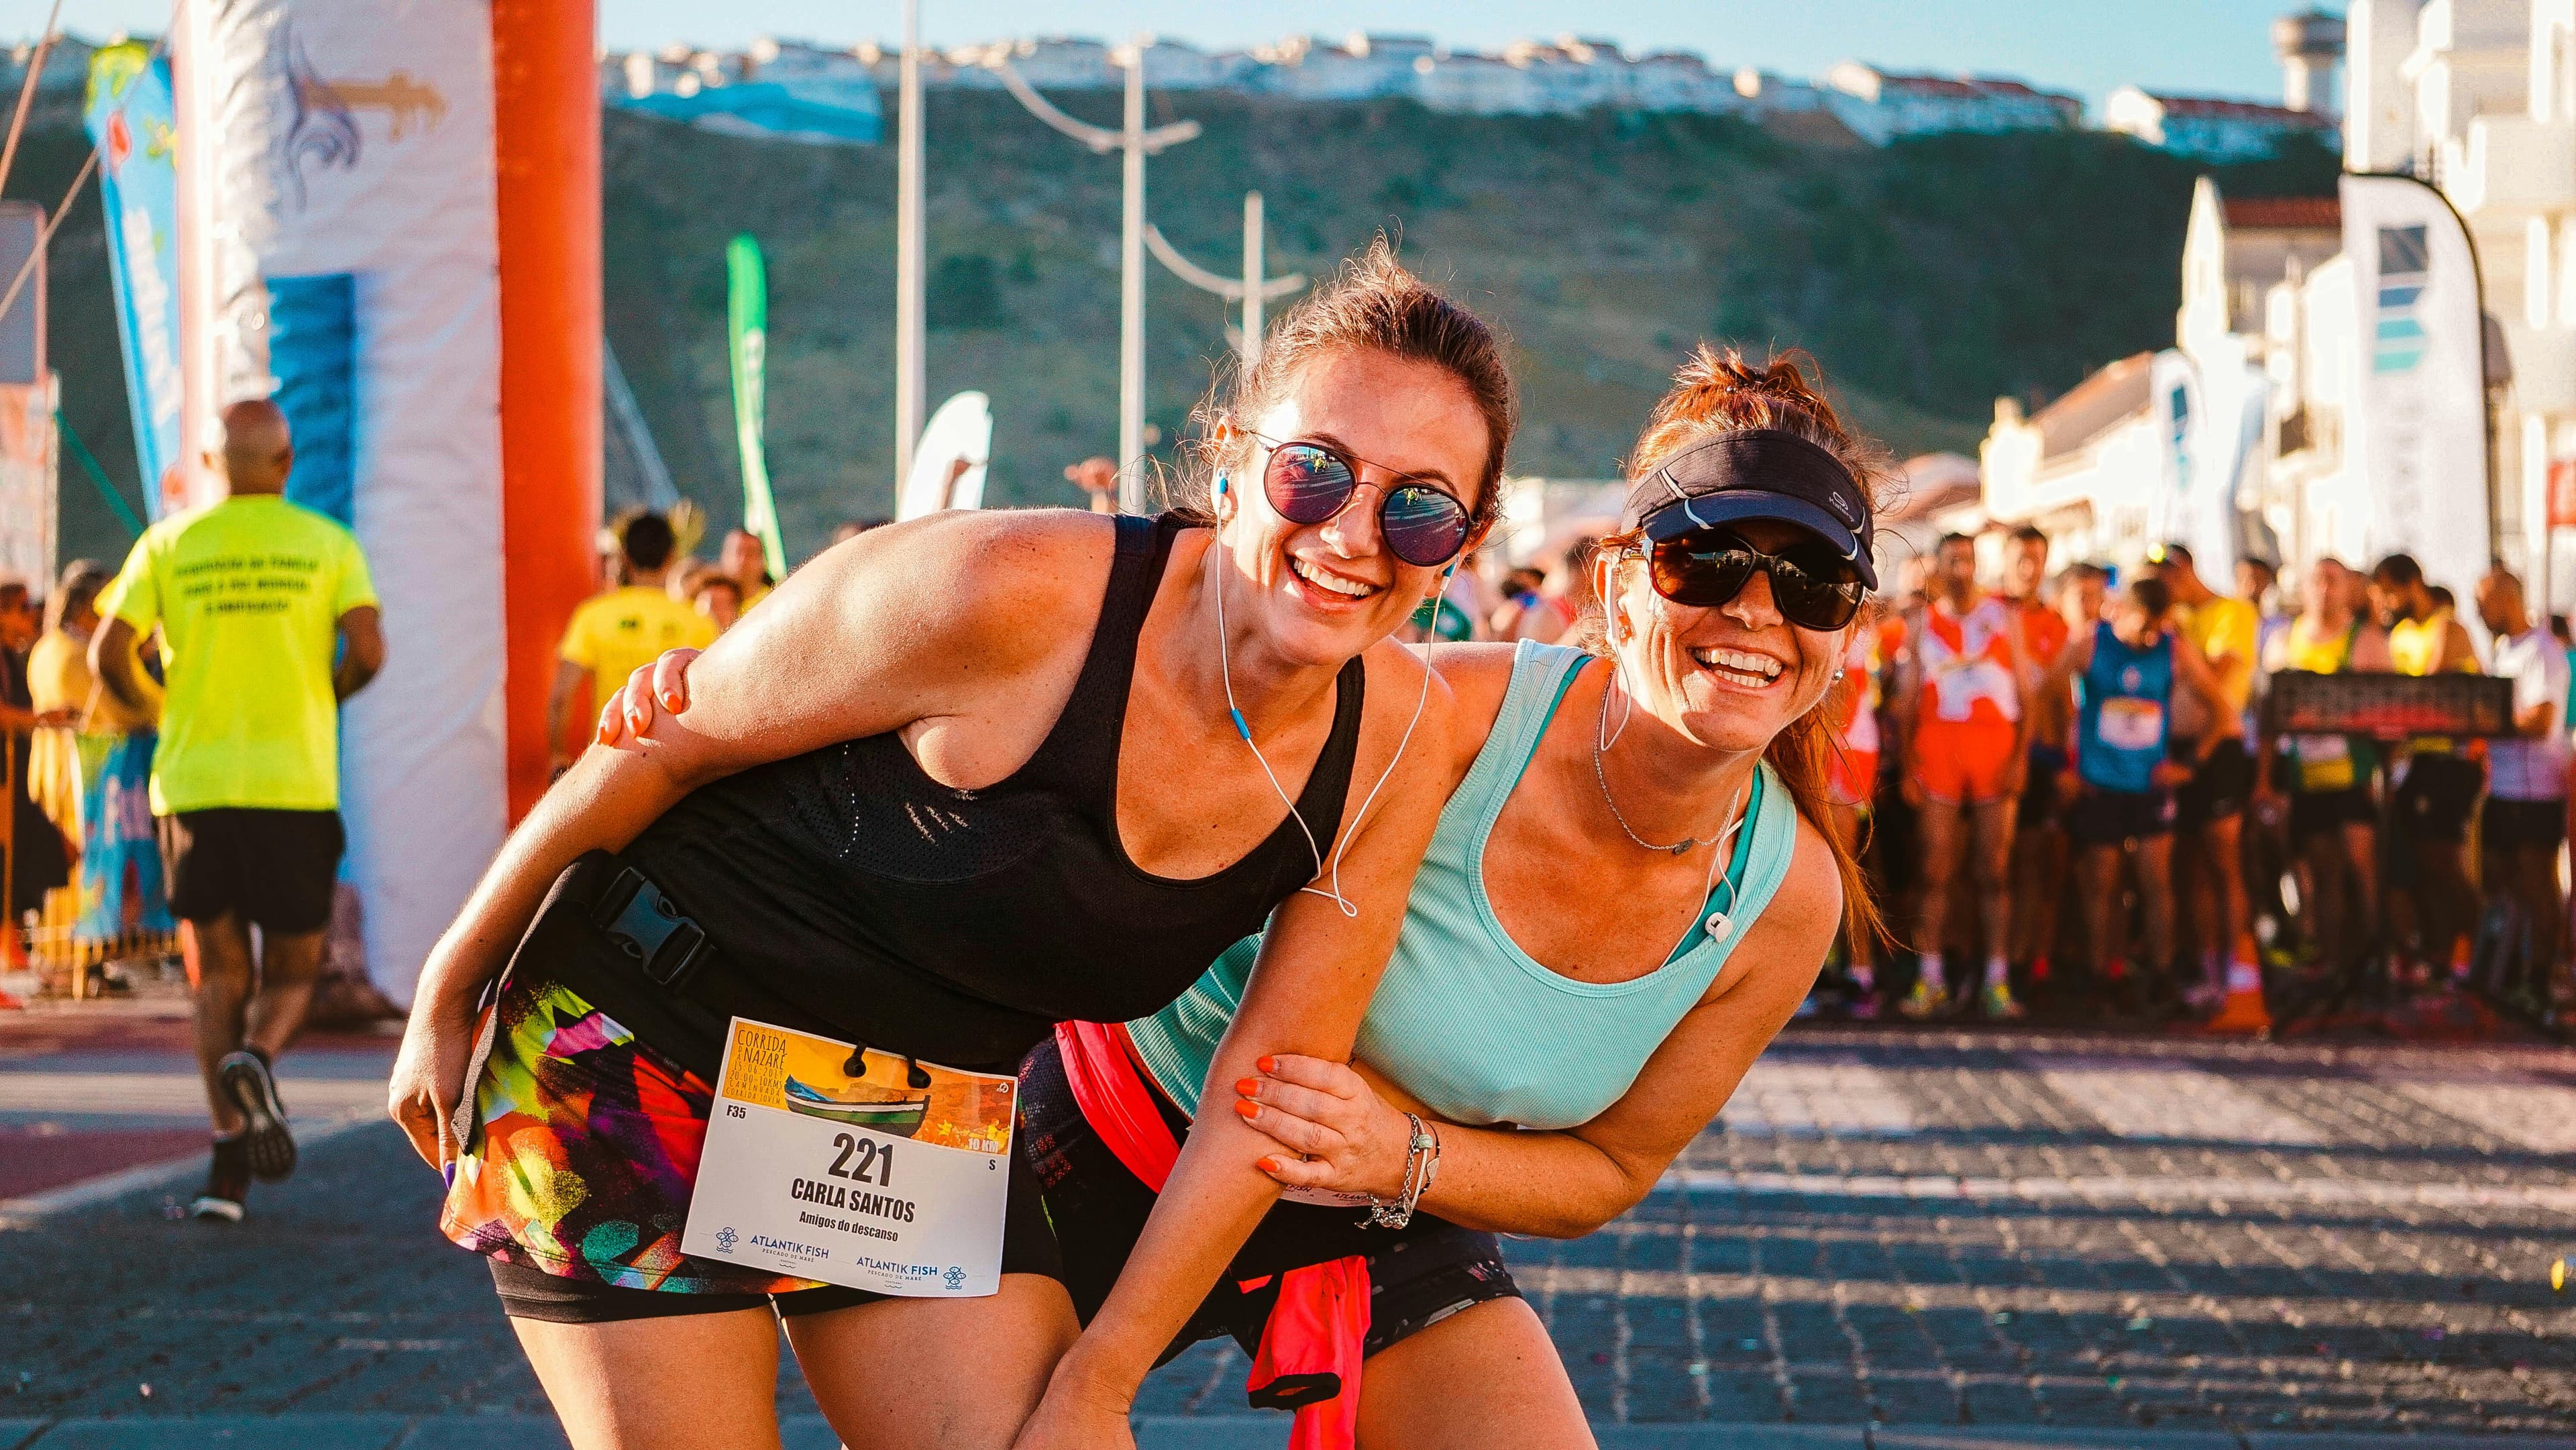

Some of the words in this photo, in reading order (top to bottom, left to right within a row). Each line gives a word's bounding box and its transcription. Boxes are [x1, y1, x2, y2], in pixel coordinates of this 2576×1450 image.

[738, 1029, 786, 1054] CORRIDA
[744, 1047, 788, 1070] NAZARÉ
[726, 1087, 756, 1100] CORRIDA
[759, 1094, 780, 1104] JOVEM
[730, 1080, 780, 1096] CAMINHADA
[727, 1104, 747, 1119] F35
[968, 1138, 980, 1150] 10
[981, 1140, 999, 1153] KM
[828, 1133, 894, 1187] 221
[989, 1159, 996, 1171] S
[791, 1178, 847, 1208] CARLA
[849, 1190, 916, 1223] SANTOS
[799, 1211, 837, 1229] Amigos
[837, 1219, 850, 1232] do
[851, 1222, 899, 1242] descanso
[750, 1235, 804, 1253] ATLANTIK
[805, 1246, 829, 1259] FISH
[762, 1249, 789, 1258] PESCADO
[856, 1256, 908, 1274] ATLANTIK
[911, 1265, 938, 1276] FISH
[867, 1270, 893, 1278] PESCADO
